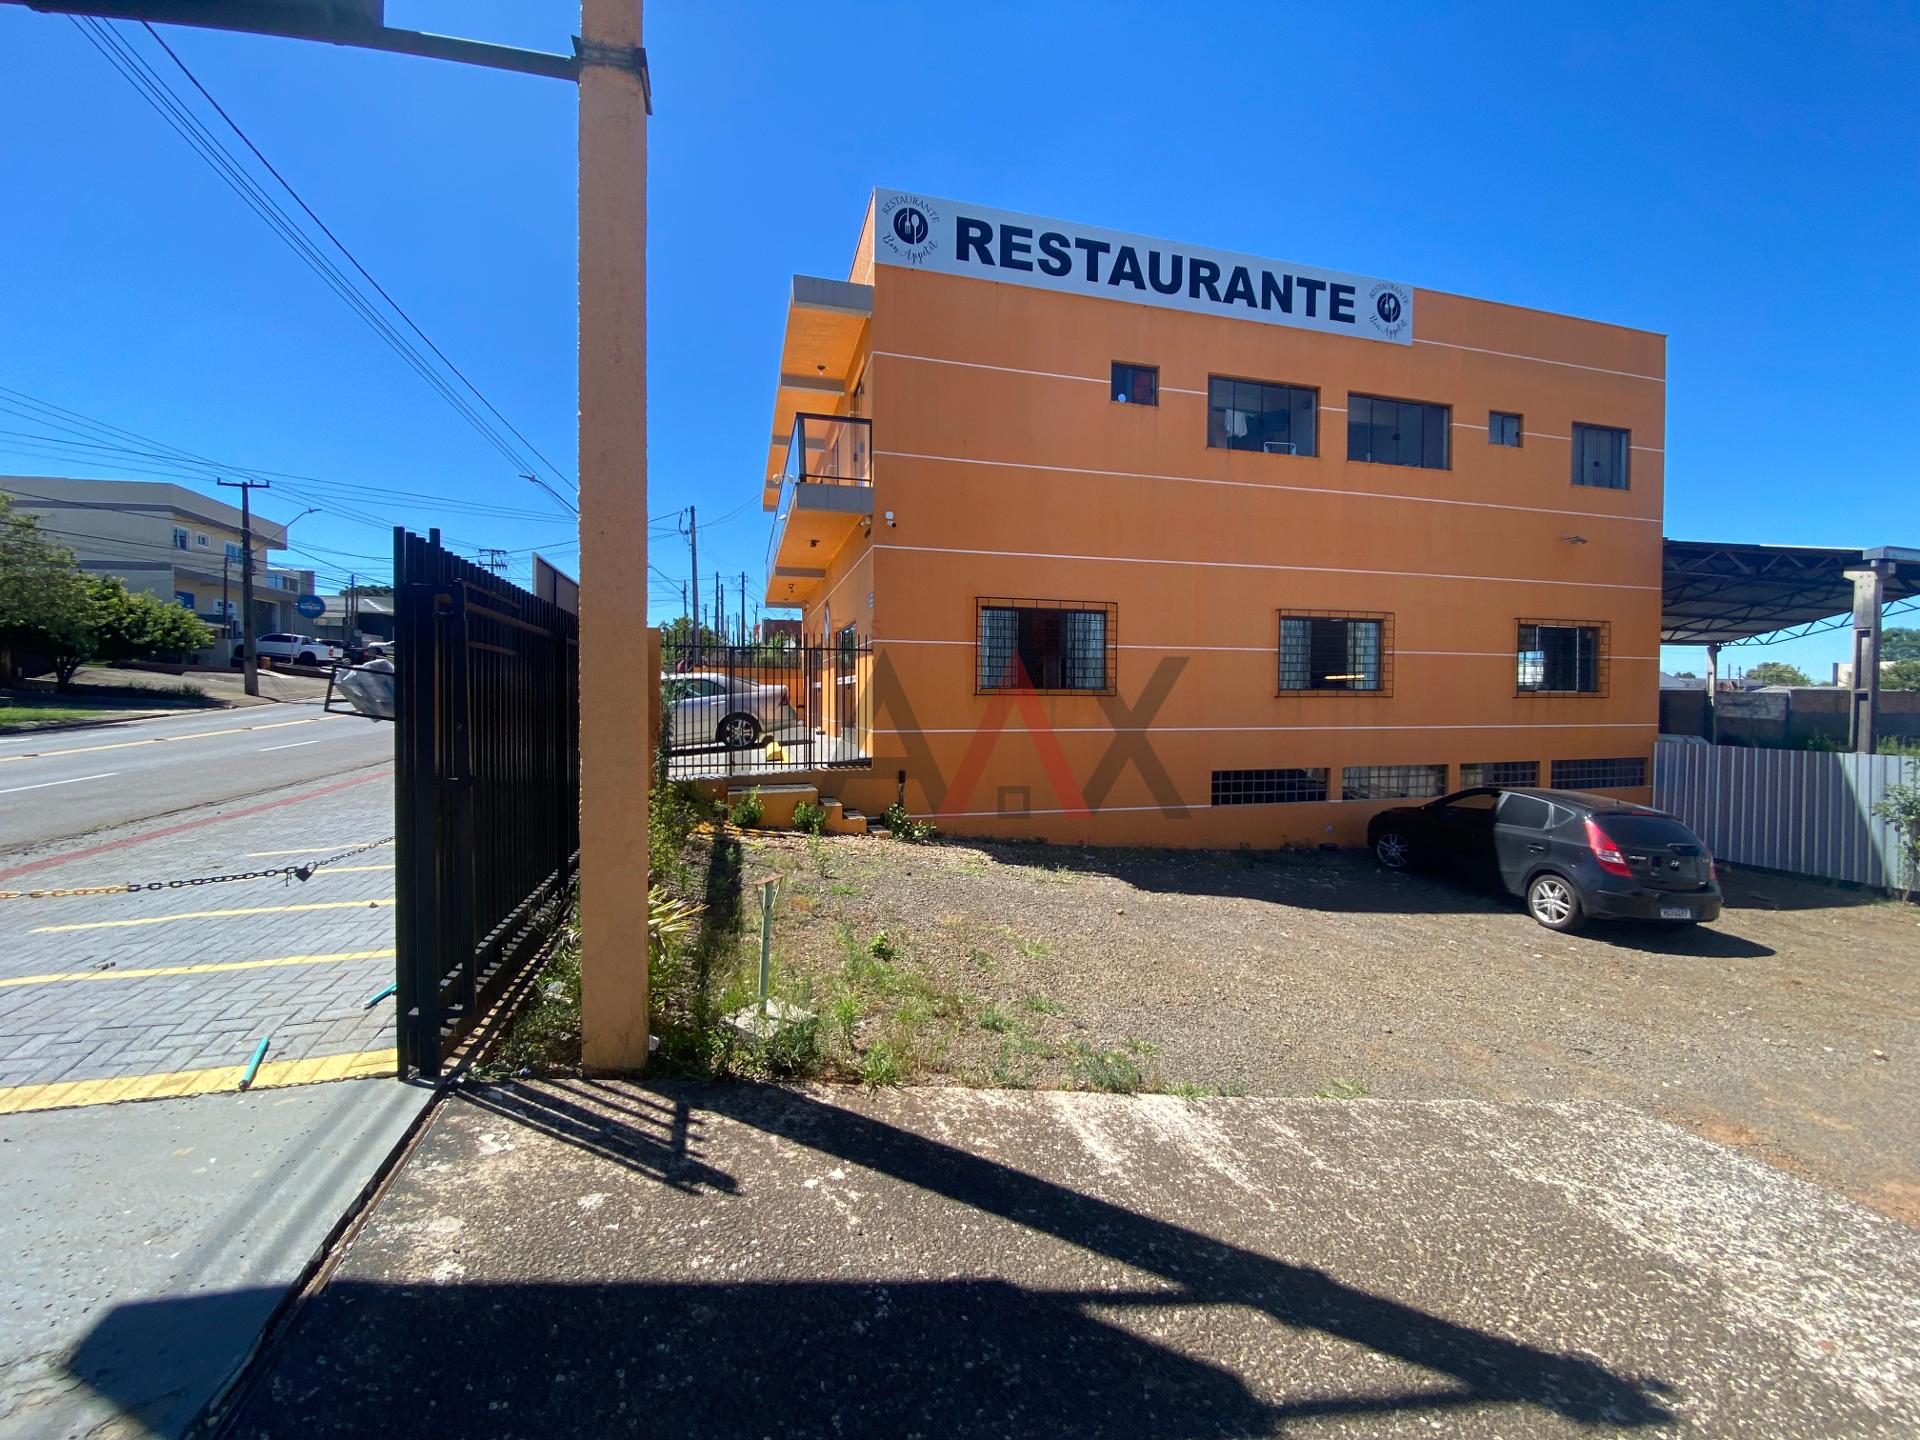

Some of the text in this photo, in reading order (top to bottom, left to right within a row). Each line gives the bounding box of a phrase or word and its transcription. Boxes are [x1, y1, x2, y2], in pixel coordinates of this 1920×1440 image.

[881, 195, 940, 223] RESTAURANTE
[882, 233, 899, 254] Bon
[956, 216, 1356, 324] RESTAURANTE
